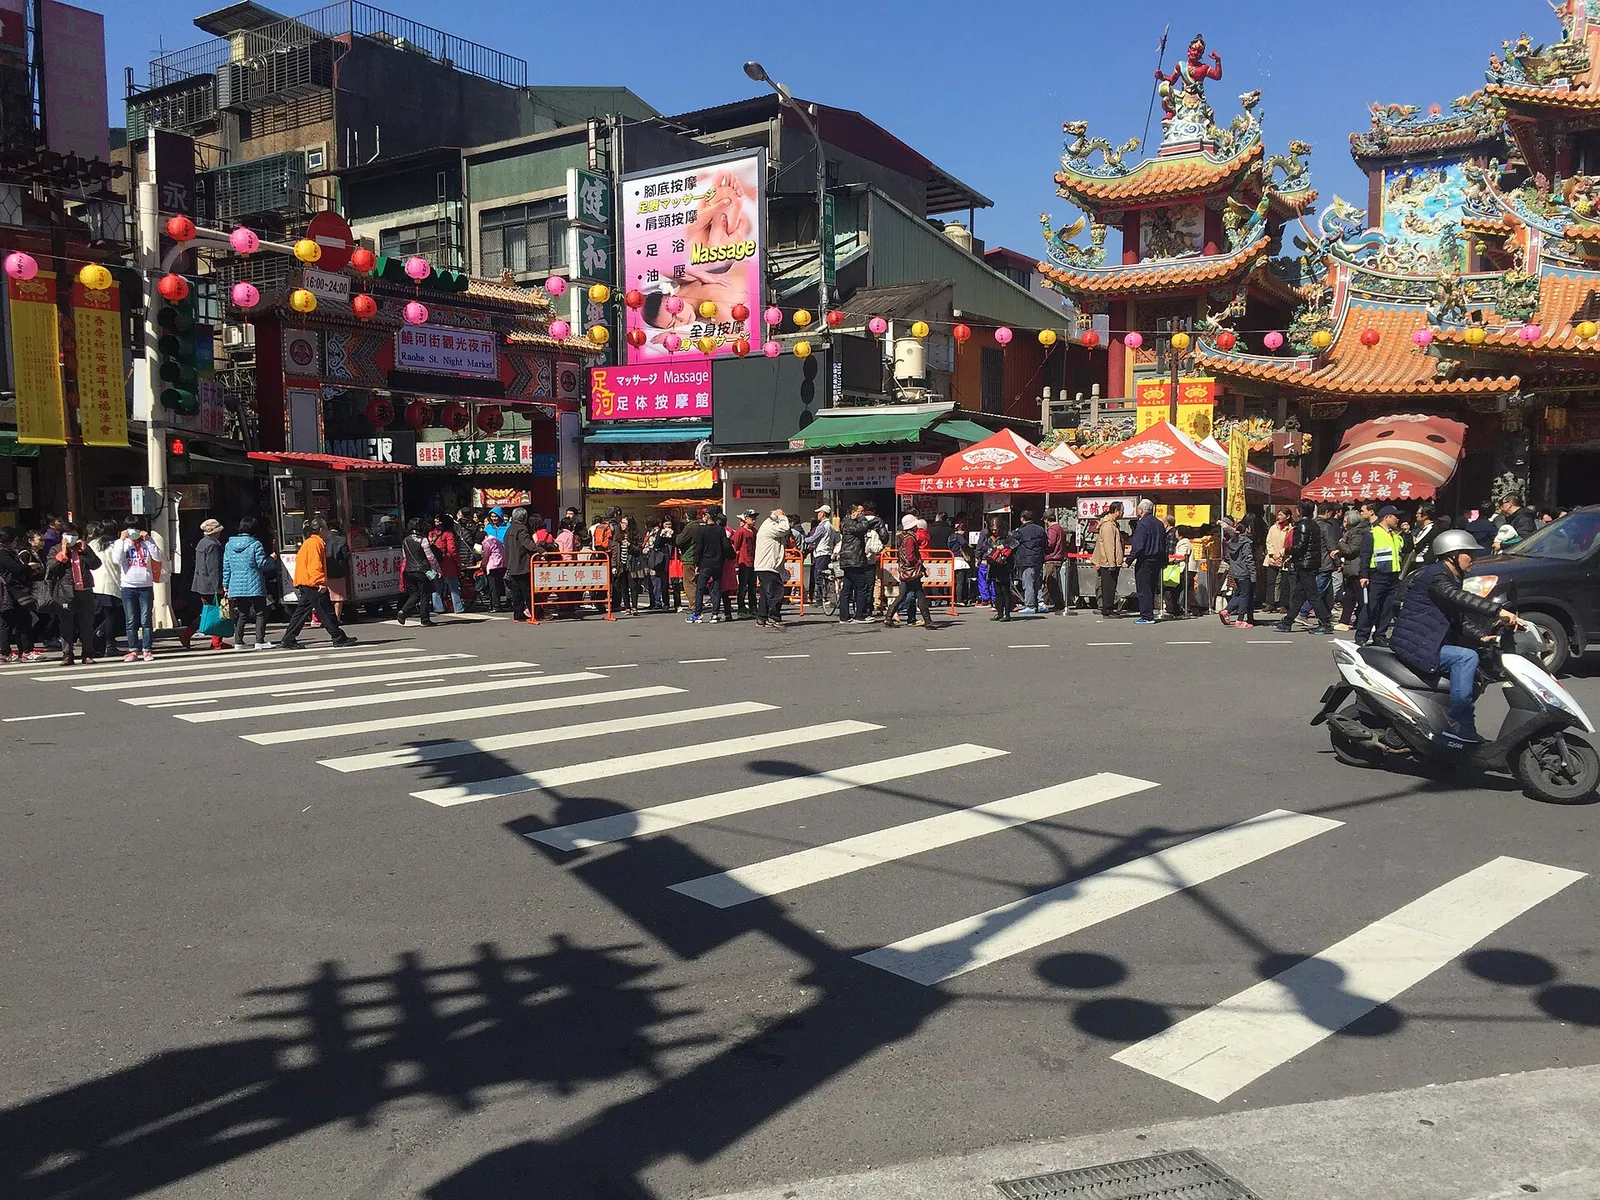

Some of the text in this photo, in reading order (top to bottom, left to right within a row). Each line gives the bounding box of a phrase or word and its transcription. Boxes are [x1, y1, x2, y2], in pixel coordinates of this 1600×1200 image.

[163, 181, 189, 211] 永
[690, 240, 756, 265] Massage
[401, 330, 492, 354] 饒河街觀光夜市
[401, 351, 493, 369] Raohe St. Night Market
[616, 372, 658, 387] マッサージ
[663, 370, 709, 386] Massage
[616, 393, 709, 411] 足体按摩館
[448, 443, 516, 464] 健和藥粧
[935, 476, 1022, 490] 台北市松山慈祐宮
[1093, 472, 1192, 487] 台北市松山慈祐宮
[1351, 468, 1399, 483] 台北市
[1320, 481, 1413, 499] 松山慈祐宮
[539, 569, 602, 583] 禁止停車
